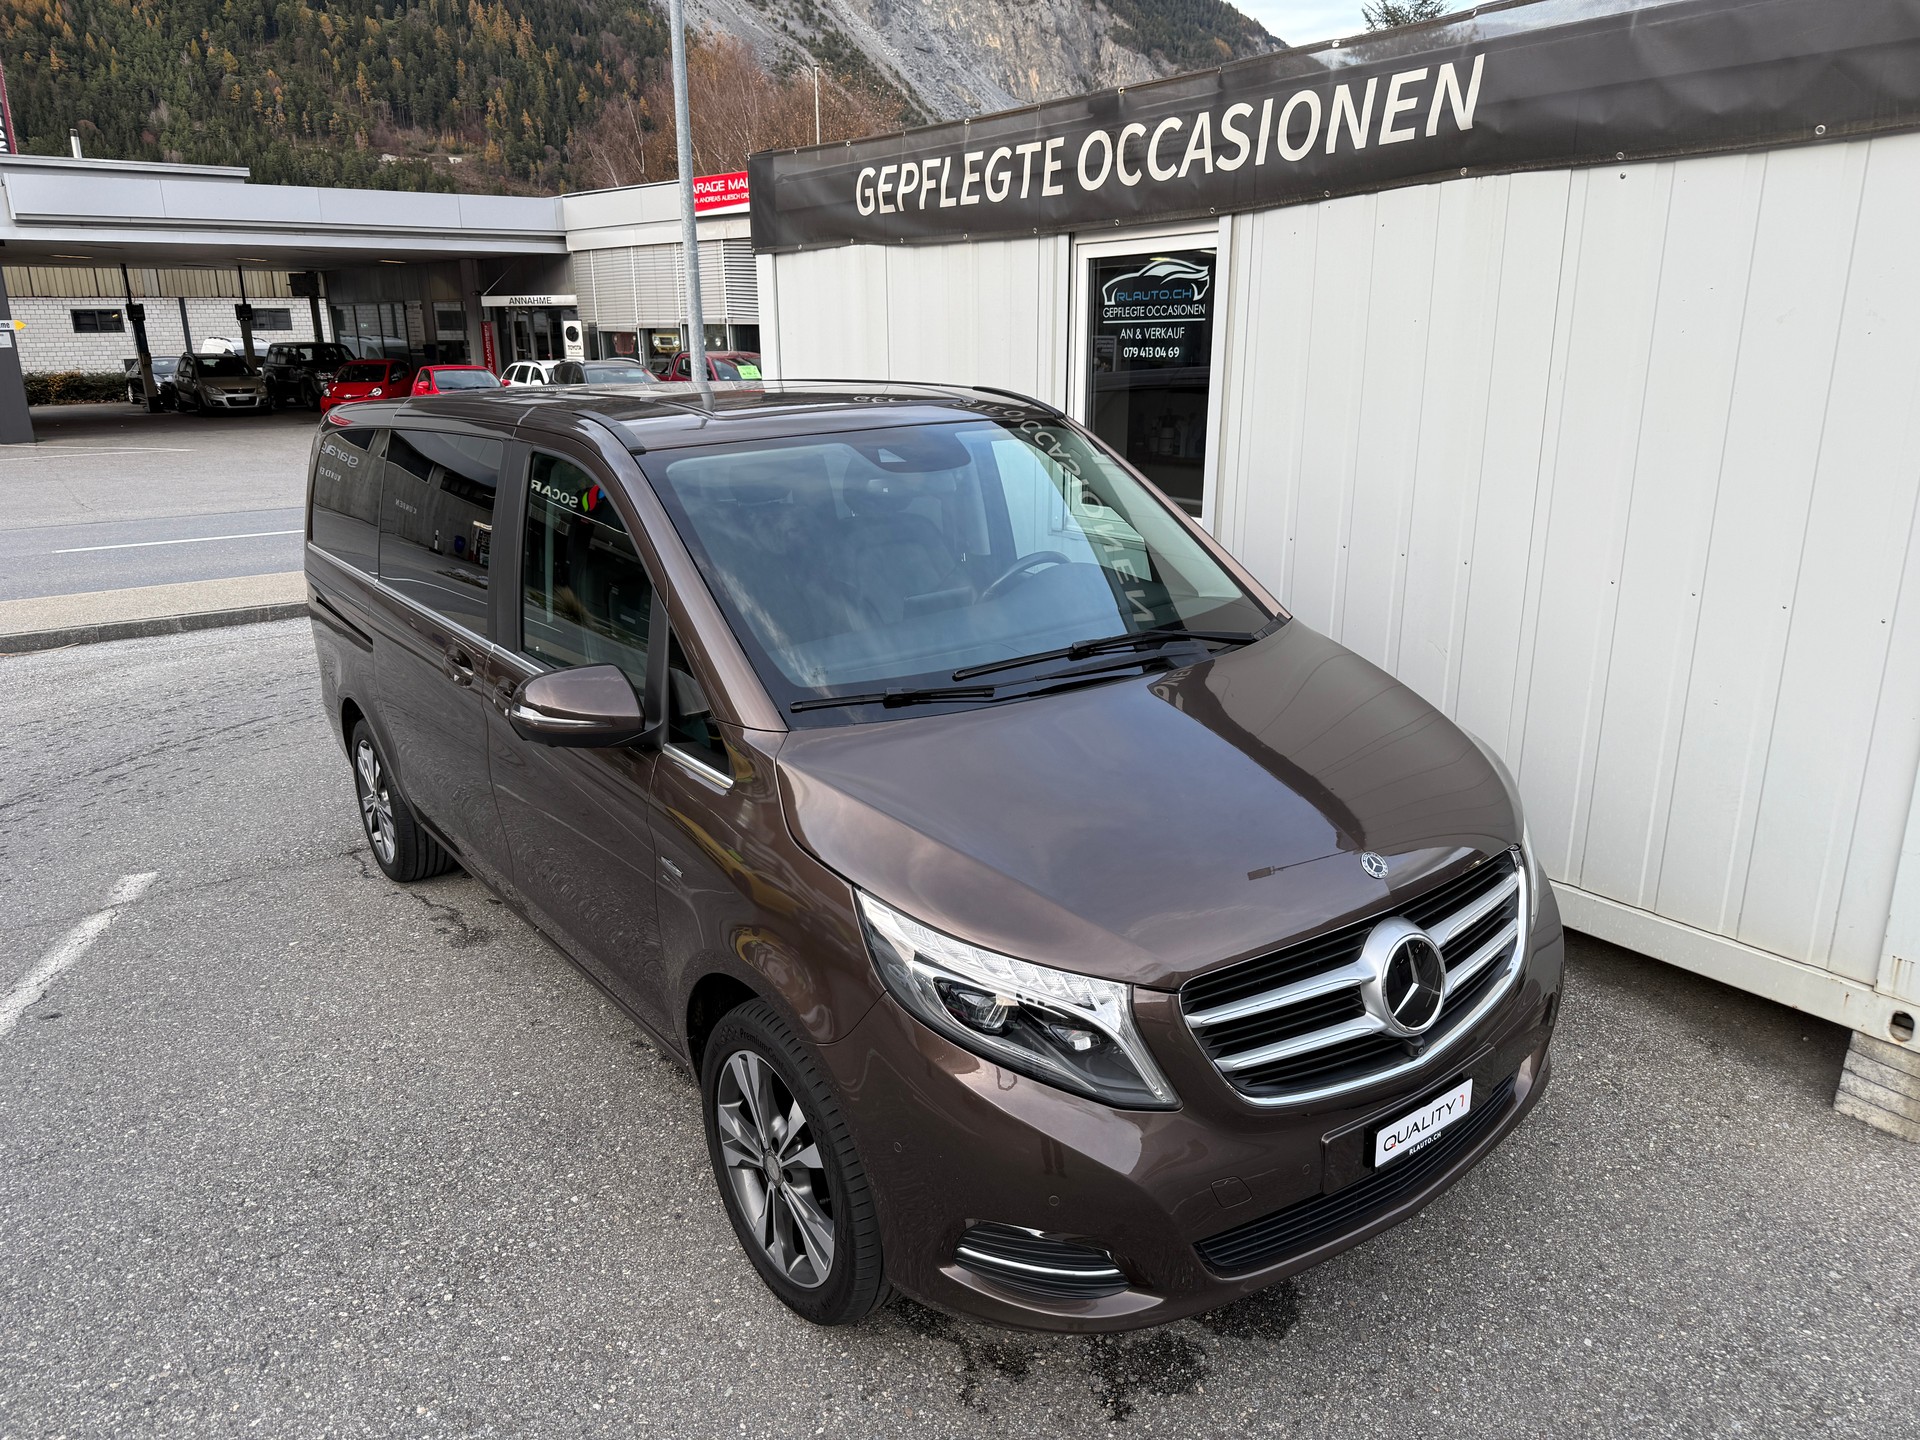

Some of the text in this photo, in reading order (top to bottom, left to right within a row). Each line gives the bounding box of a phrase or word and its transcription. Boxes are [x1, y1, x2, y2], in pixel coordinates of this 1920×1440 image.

[854, 53, 1486, 217] GEPFLEGTE OCCASIONEN
[509, 297, 552, 305] ANNAHME
[1116, 288, 1193, 302] RLAUTO.CH
[1102, 303, 1206, 318] GEPFLEGTE OCCASIONEN
[1120, 326, 1186, 340] AN & VERKAUF
[1123, 346, 1138, 358] 079
[1139, 346, 1153, 358] 413
[1155, 346, 1167, 358] 04
[1168, 346, 1180, 358] 69
[1383, 1094, 1465, 1152] QUALITY 1
[1409, 1131, 1442, 1156] RLAUTO.CH
